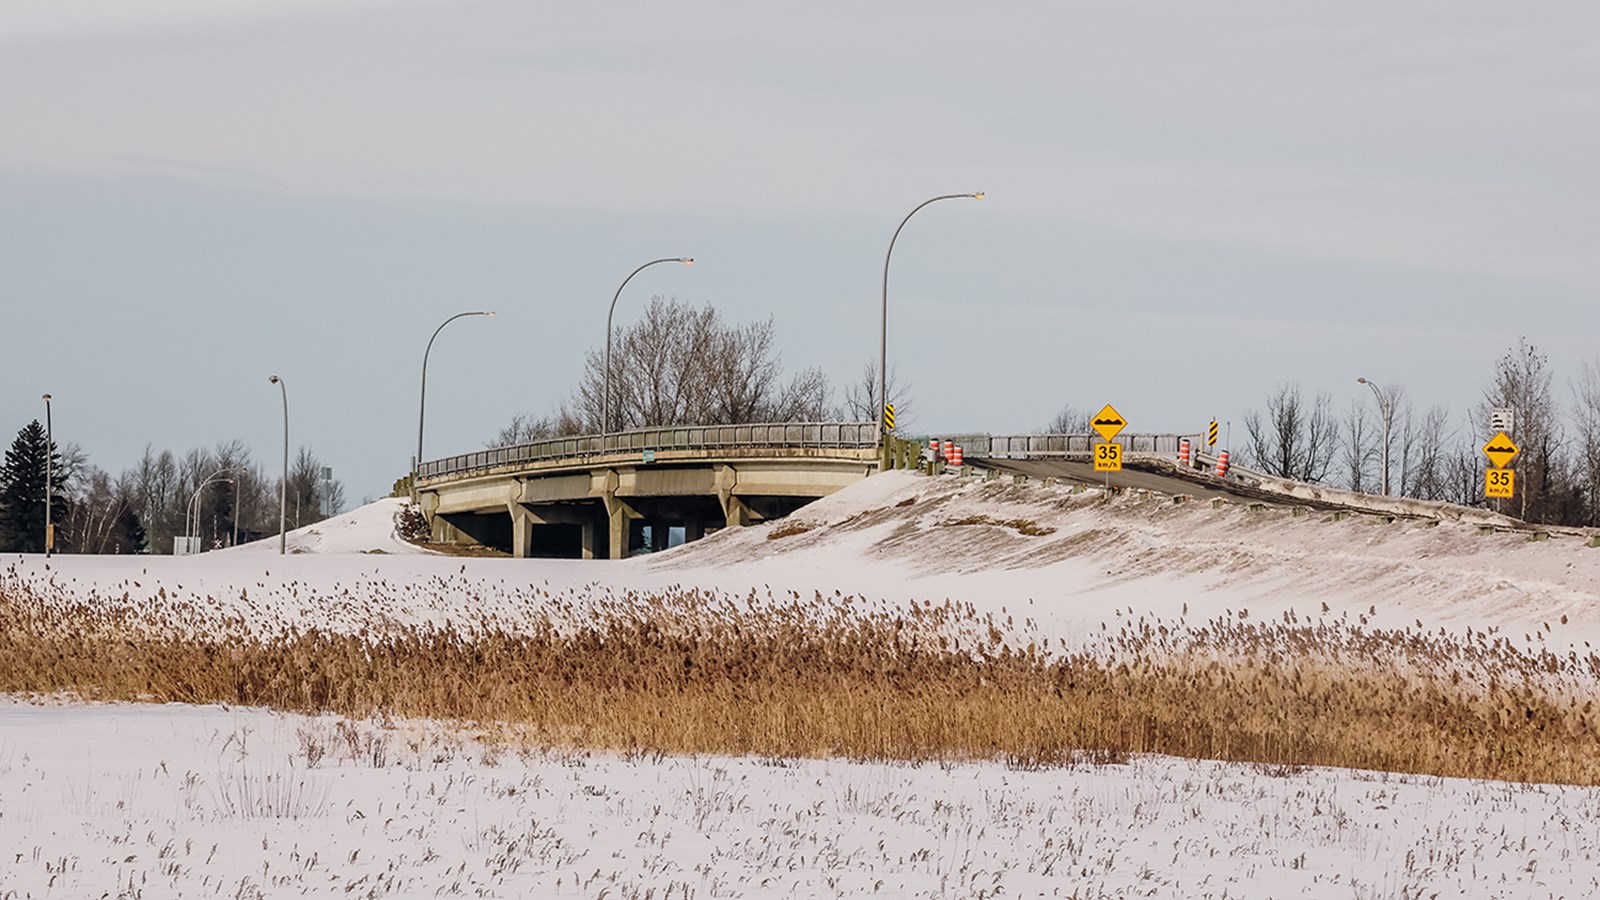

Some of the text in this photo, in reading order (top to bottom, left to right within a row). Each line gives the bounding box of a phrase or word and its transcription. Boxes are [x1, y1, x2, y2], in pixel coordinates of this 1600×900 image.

[1098, 446, 1117, 460] 35
[1098, 461, 1118, 469] km/h
[1490, 471, 1510, 486] 35
